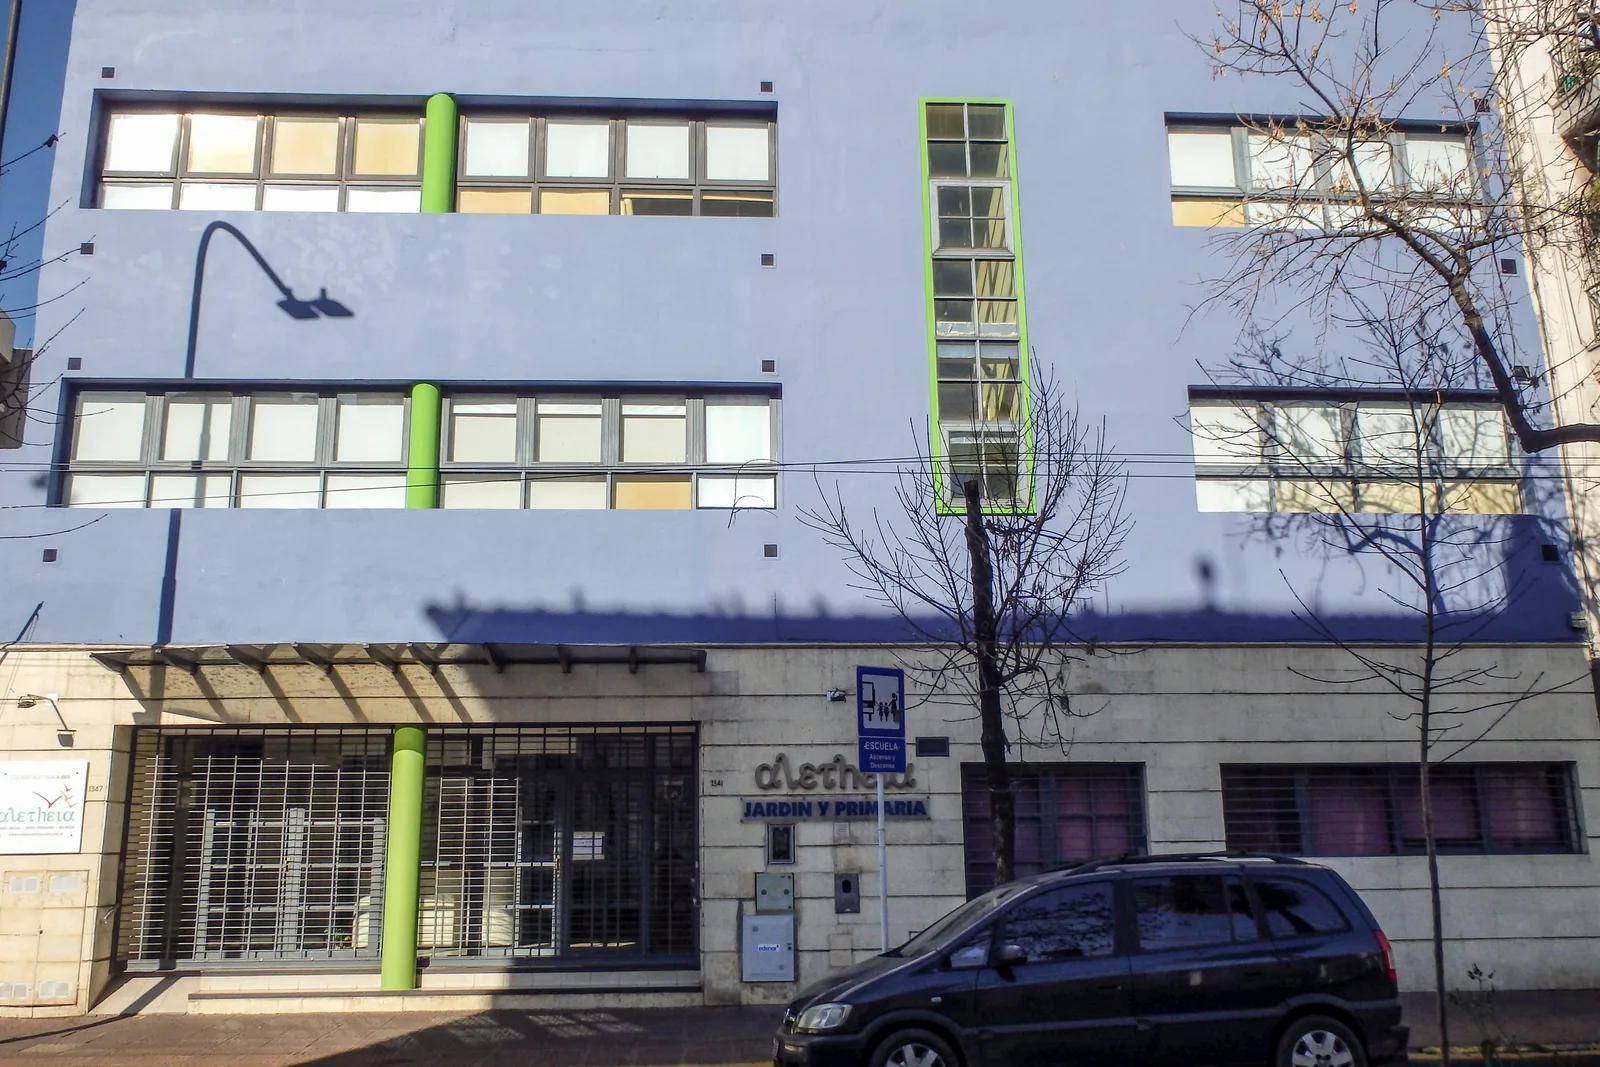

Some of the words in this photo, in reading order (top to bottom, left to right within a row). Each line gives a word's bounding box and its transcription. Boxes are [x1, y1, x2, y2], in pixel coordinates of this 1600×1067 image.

[892, 755, 896, 763] y
[744, 801, 812, 817] JARDIN
[817, 801, 830, 817] Y
[835, 801, 927, 816] PRIMARIA
